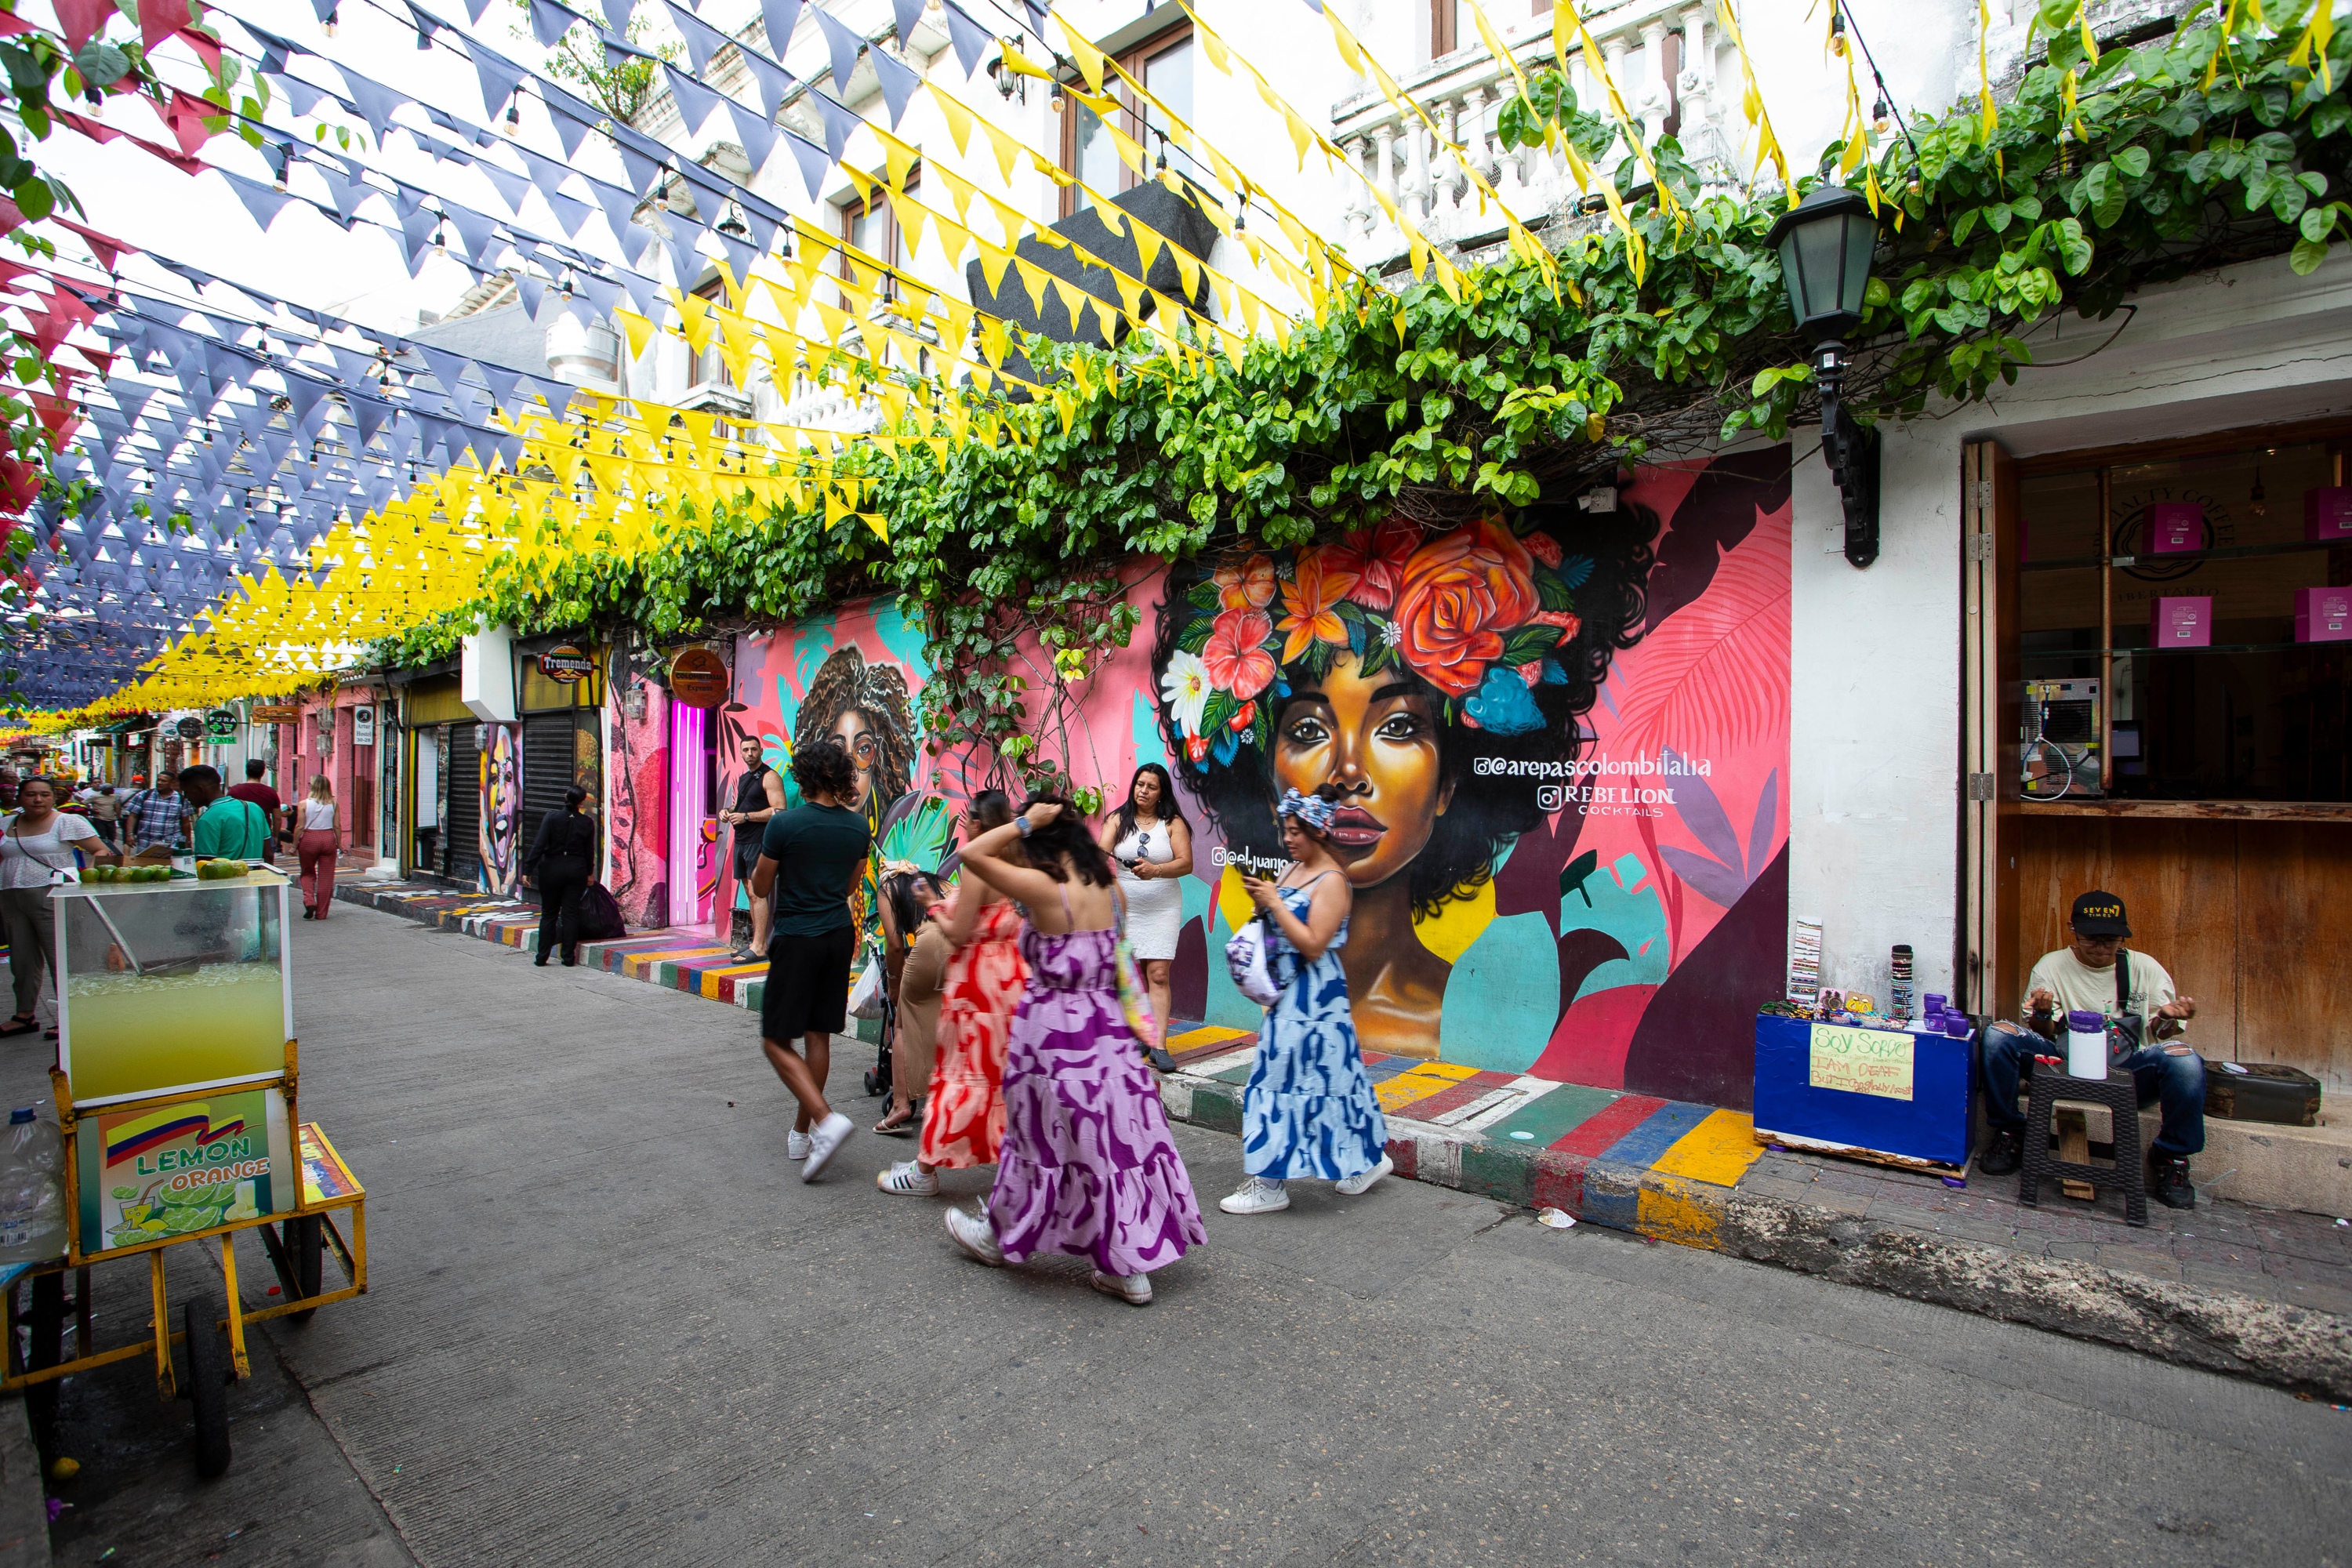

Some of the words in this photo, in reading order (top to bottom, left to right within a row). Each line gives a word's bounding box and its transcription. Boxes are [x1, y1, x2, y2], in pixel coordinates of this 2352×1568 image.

[2183, 489, 2234, 546] COFFEE
[2112, 587, 2220, 604] IBERTARIO
[543, 656, 592, 671] Tremenda
[1490, 750, 1711, 780] @arepascolombitalia
[1563, 786, 1679, 805] REBELION
[1577, 804, 1664, 818] COCKTAILS
[1858, 1062, 1901, 1077] DEAF
[136, 1137, 252, 1176] LEMON
[169, 1156, 270, 1192] ORANGE
